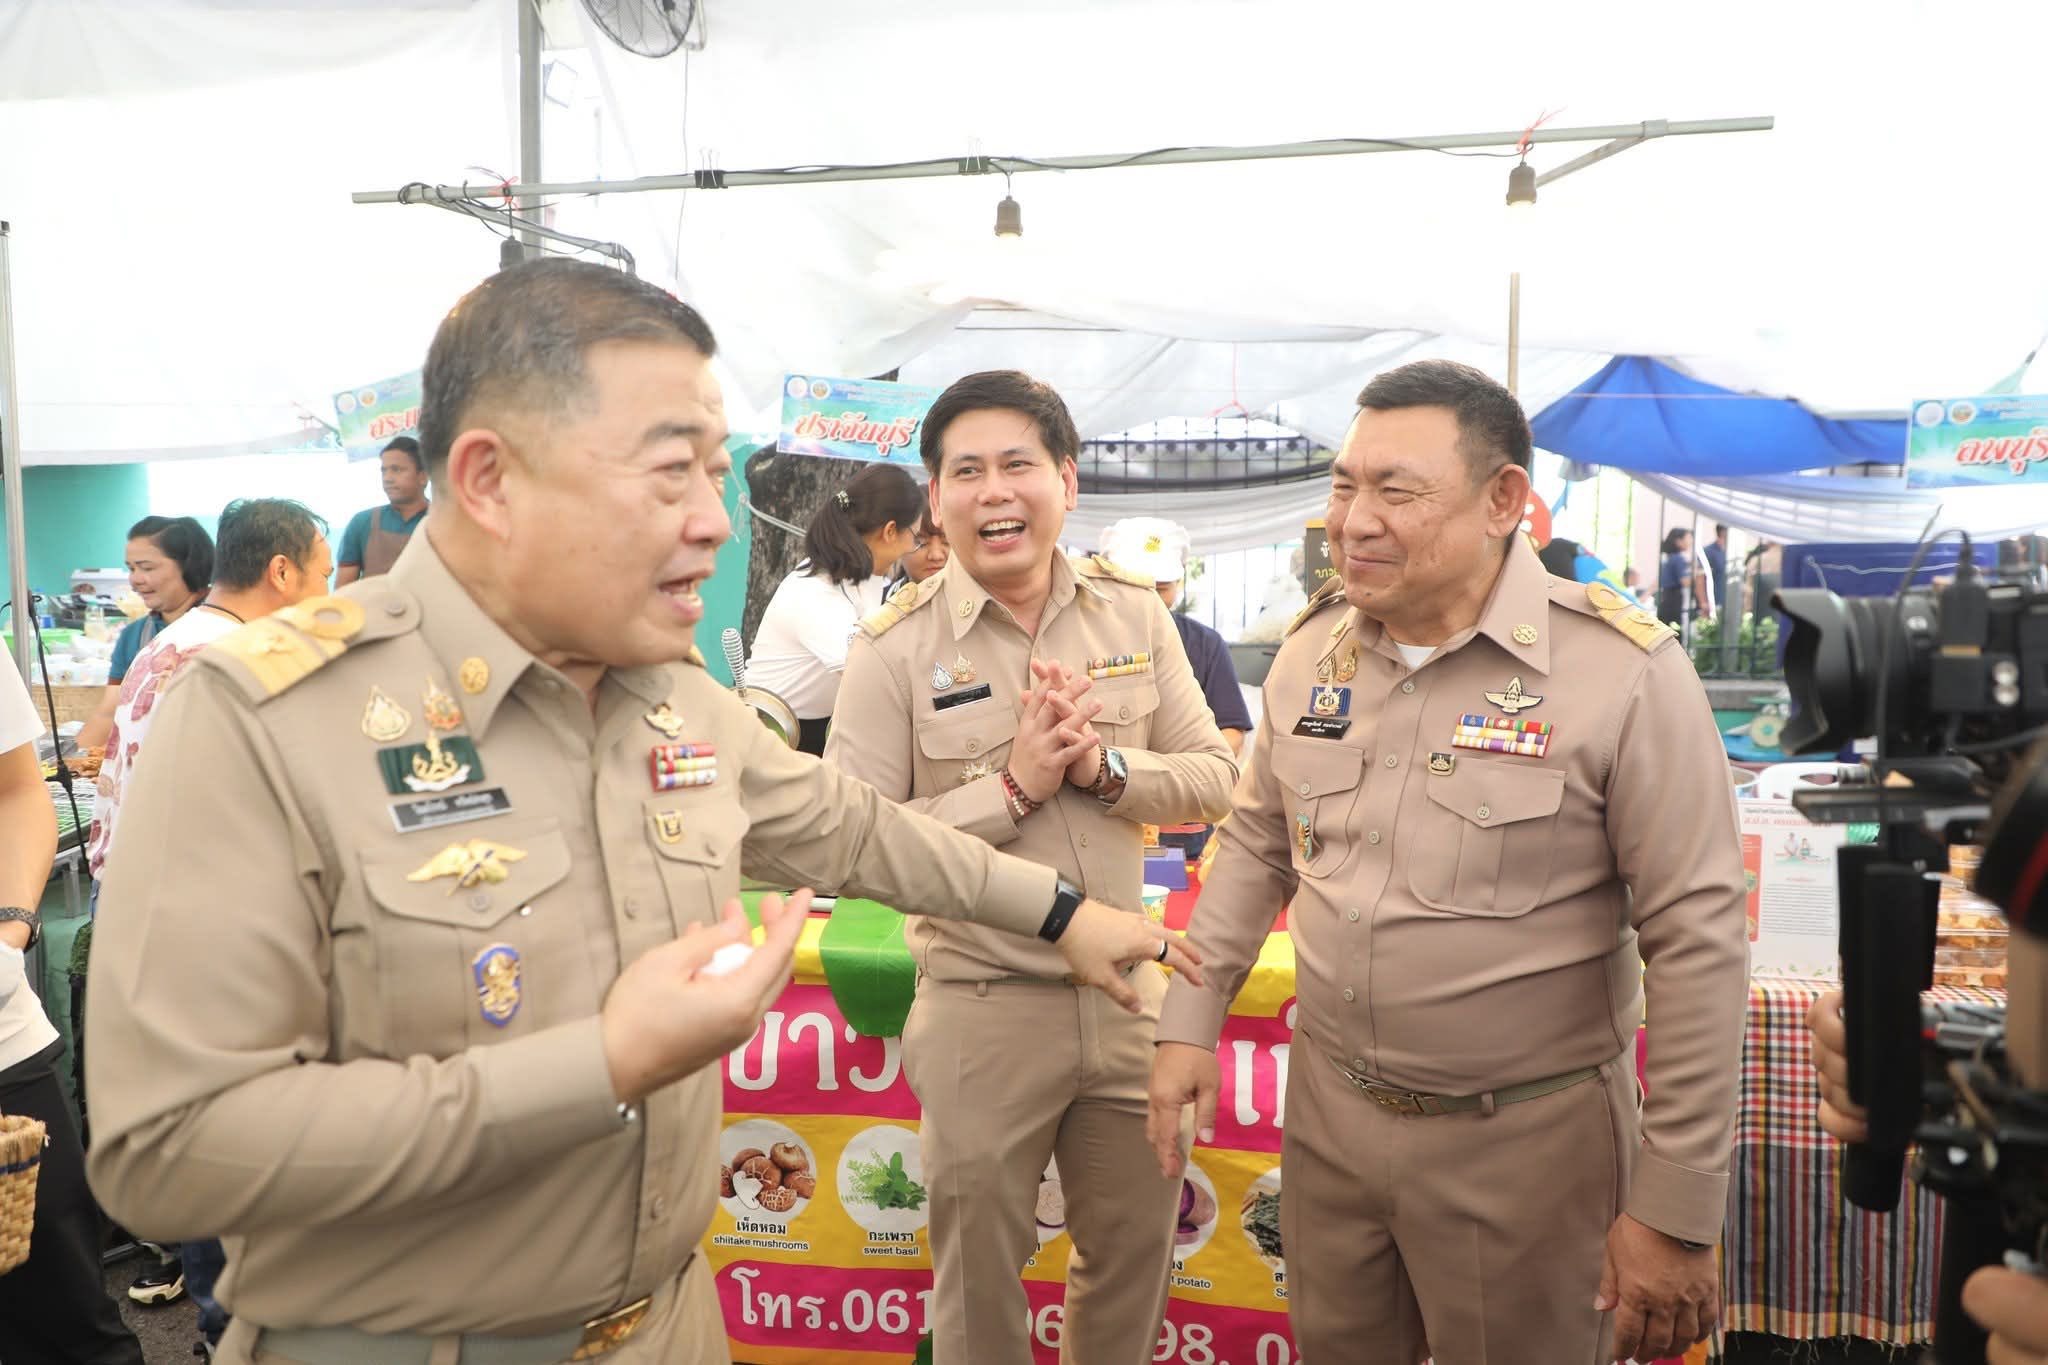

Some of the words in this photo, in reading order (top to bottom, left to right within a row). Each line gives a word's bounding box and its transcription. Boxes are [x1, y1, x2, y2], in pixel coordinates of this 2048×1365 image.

[794, 411, 918, 456] ปราจีนบุรี
[736, 1216, 786, 1234] เห็ดหอม
[714, 1235, 751, 1246] shiitake
[753, 1239, 809, 1250] mushrooms
[869, 1231, 913, 1242] กะเพรา
[863, 1247, 893, 1255] sweet
[895, 1246, 919, 1256] basil
[1177, 1276, 1211, 1289] potato
[731, 1267, 933, 1335] โทร.061
